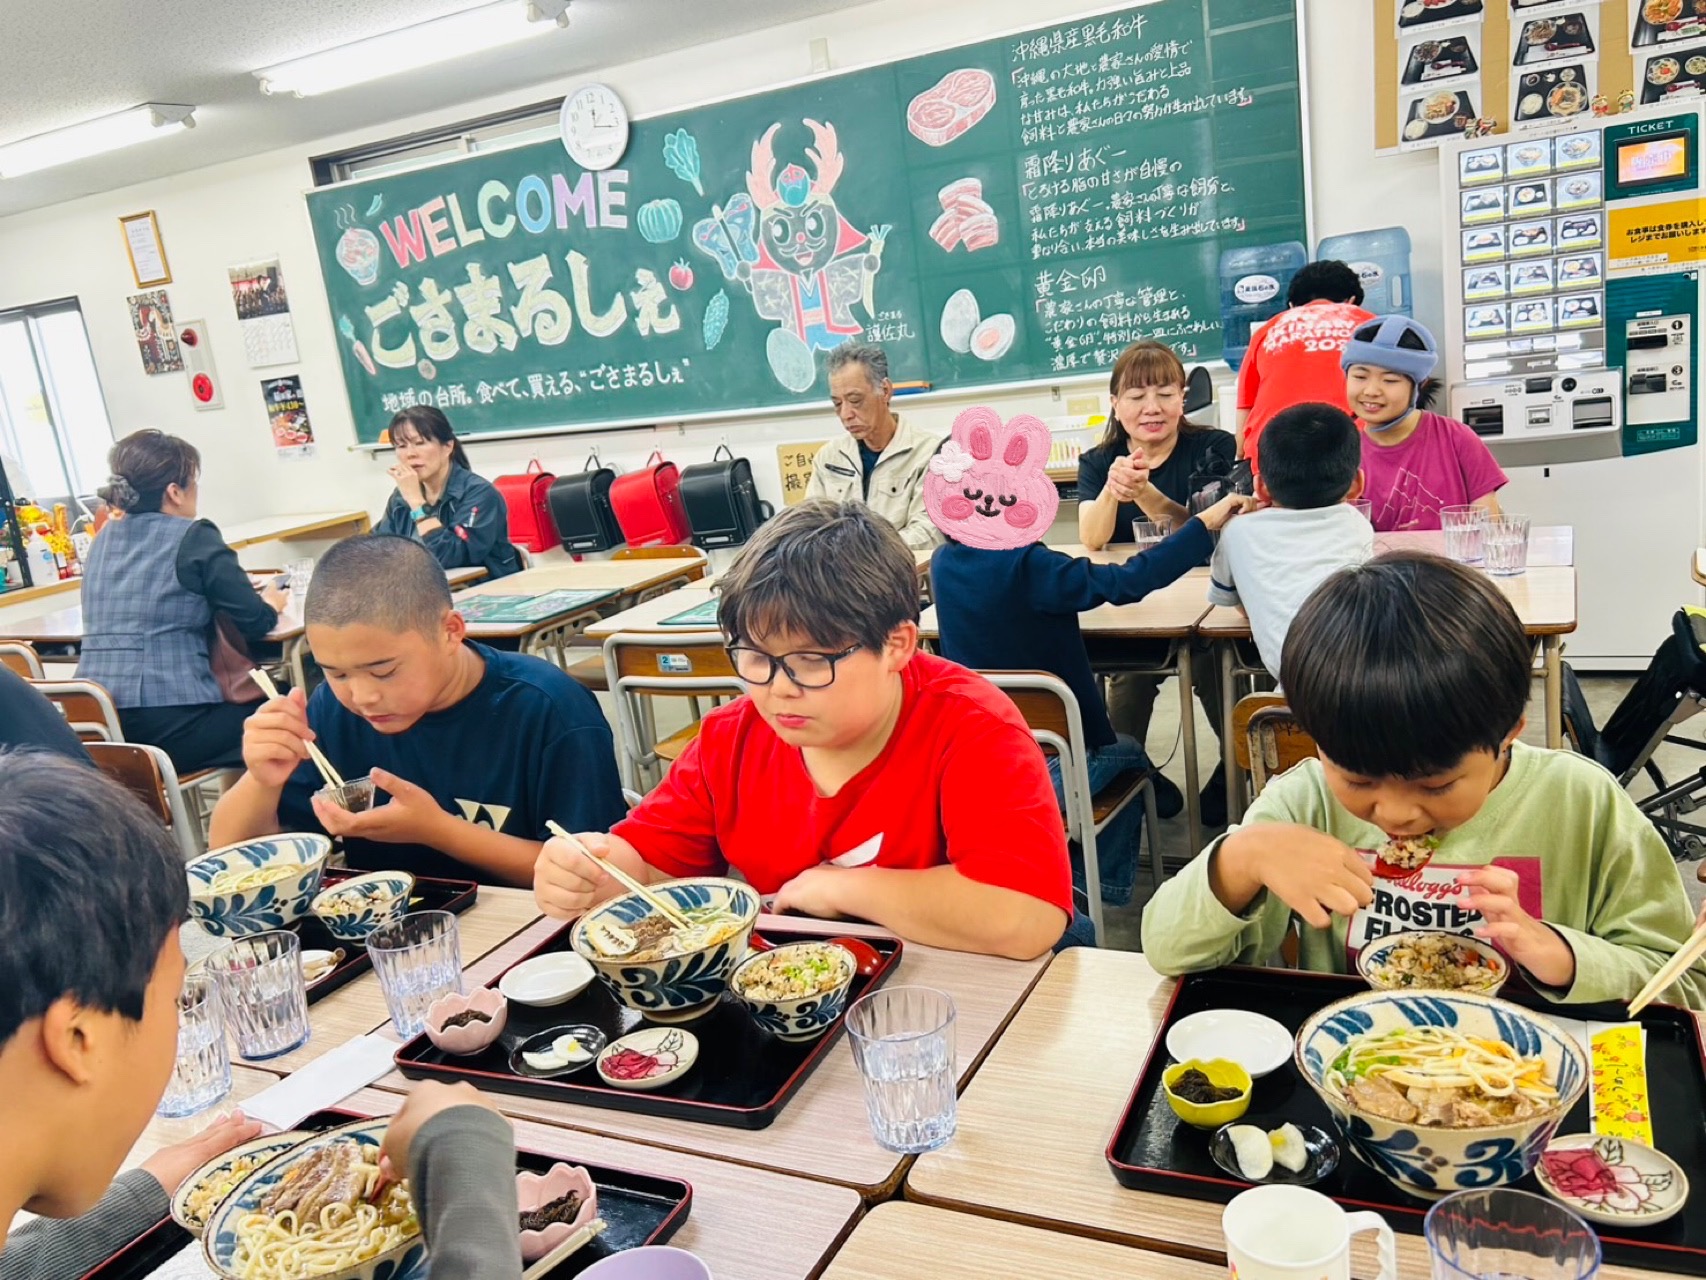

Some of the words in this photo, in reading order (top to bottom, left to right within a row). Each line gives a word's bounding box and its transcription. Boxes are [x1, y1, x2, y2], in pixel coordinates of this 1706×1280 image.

[1012, 14, 1148, 62] 沖縄県産黒毛和牛
[1628, 120, 1674, 135] TICKET
[1024, 145, 1127, 179] 霜降りあぐー
[379, 169, 629, 269] WELCOME
[1626, 219, 1706, 236] お食事は食券を購入し
[1034, 265, 1106, 298] 黄金卵
[364, 249, 681, 369] ごさまるしぇ
